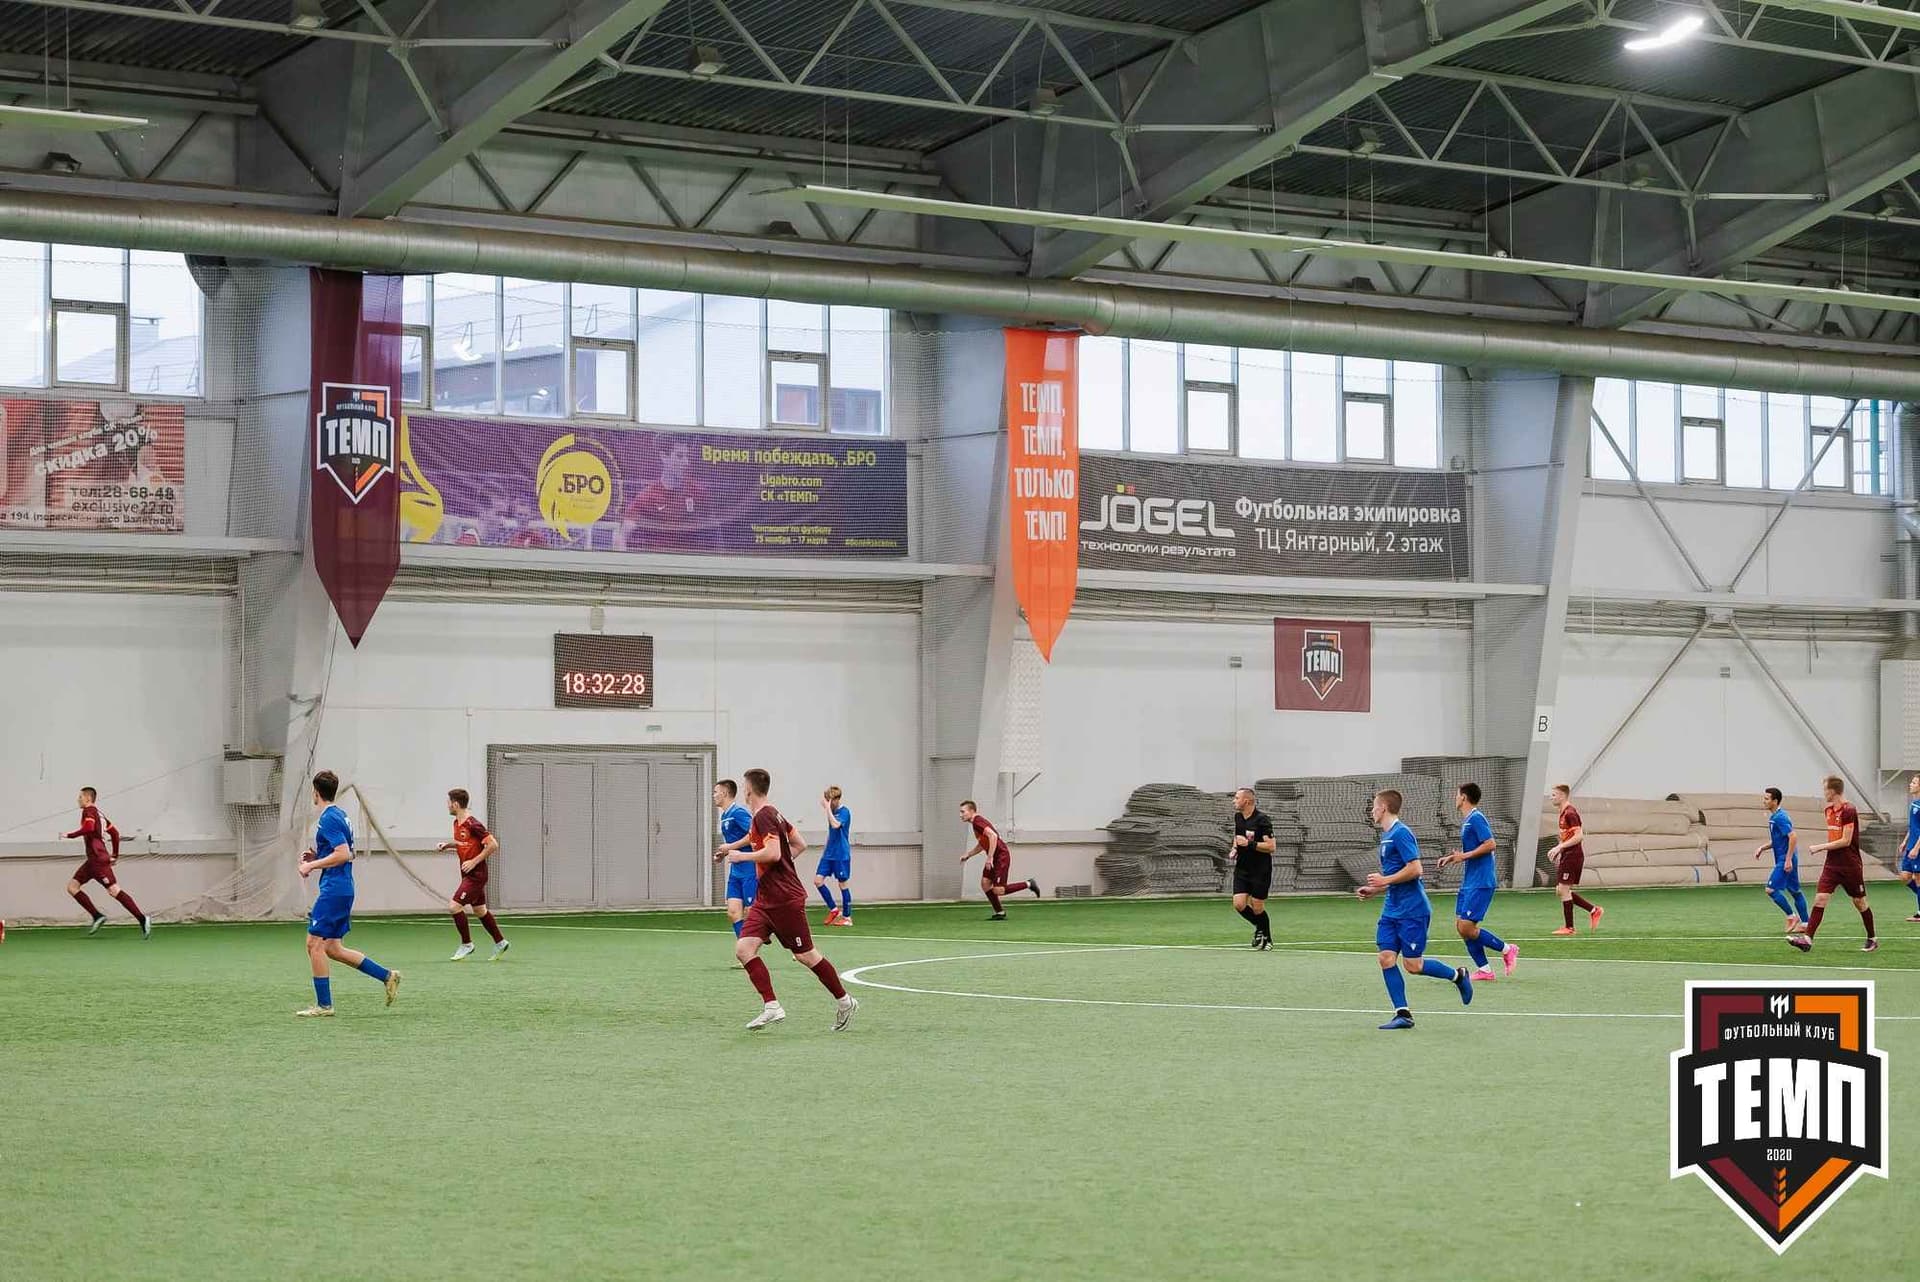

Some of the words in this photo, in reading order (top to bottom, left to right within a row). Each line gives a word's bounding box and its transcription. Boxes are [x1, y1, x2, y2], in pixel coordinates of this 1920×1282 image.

[1020, 383, 1066, 416] ТЕМП,
[112, 424, 158, 453] 20%
[326, 418, 387, 460] ТЕМП
[1021, 425, 1066, 460] ТЕМП,
[702, 445, 749, 464] Время
[755, 448, 839, 467] побеждать,
[558, 473, 605, 495] .БРО
[761, 490, 775, 501] СК
[1014, 467, 1075, 499] ТОЛЬКО
[1024, 510, 1067, 541] ТЕМП!
[1235, 496, 1349, 523] Футбольная
[1353, 505, 1461, 527] экипировка
[1081, 540, 1160, 554] технологии
[1161, 544, 1236, 558] результата
[1255, 527, 1281, 554] ТЦ
[1285, 529, 1380, 555] Янтарный,
[1385, 531, 1396, 552] 2
[1400, 536, 1444, 553] этаж
[1306, 650, 1339, 674] ТЕМП
[563, 672, 645, 695] 18:32:28
[795, 936, 803, 948] 9
